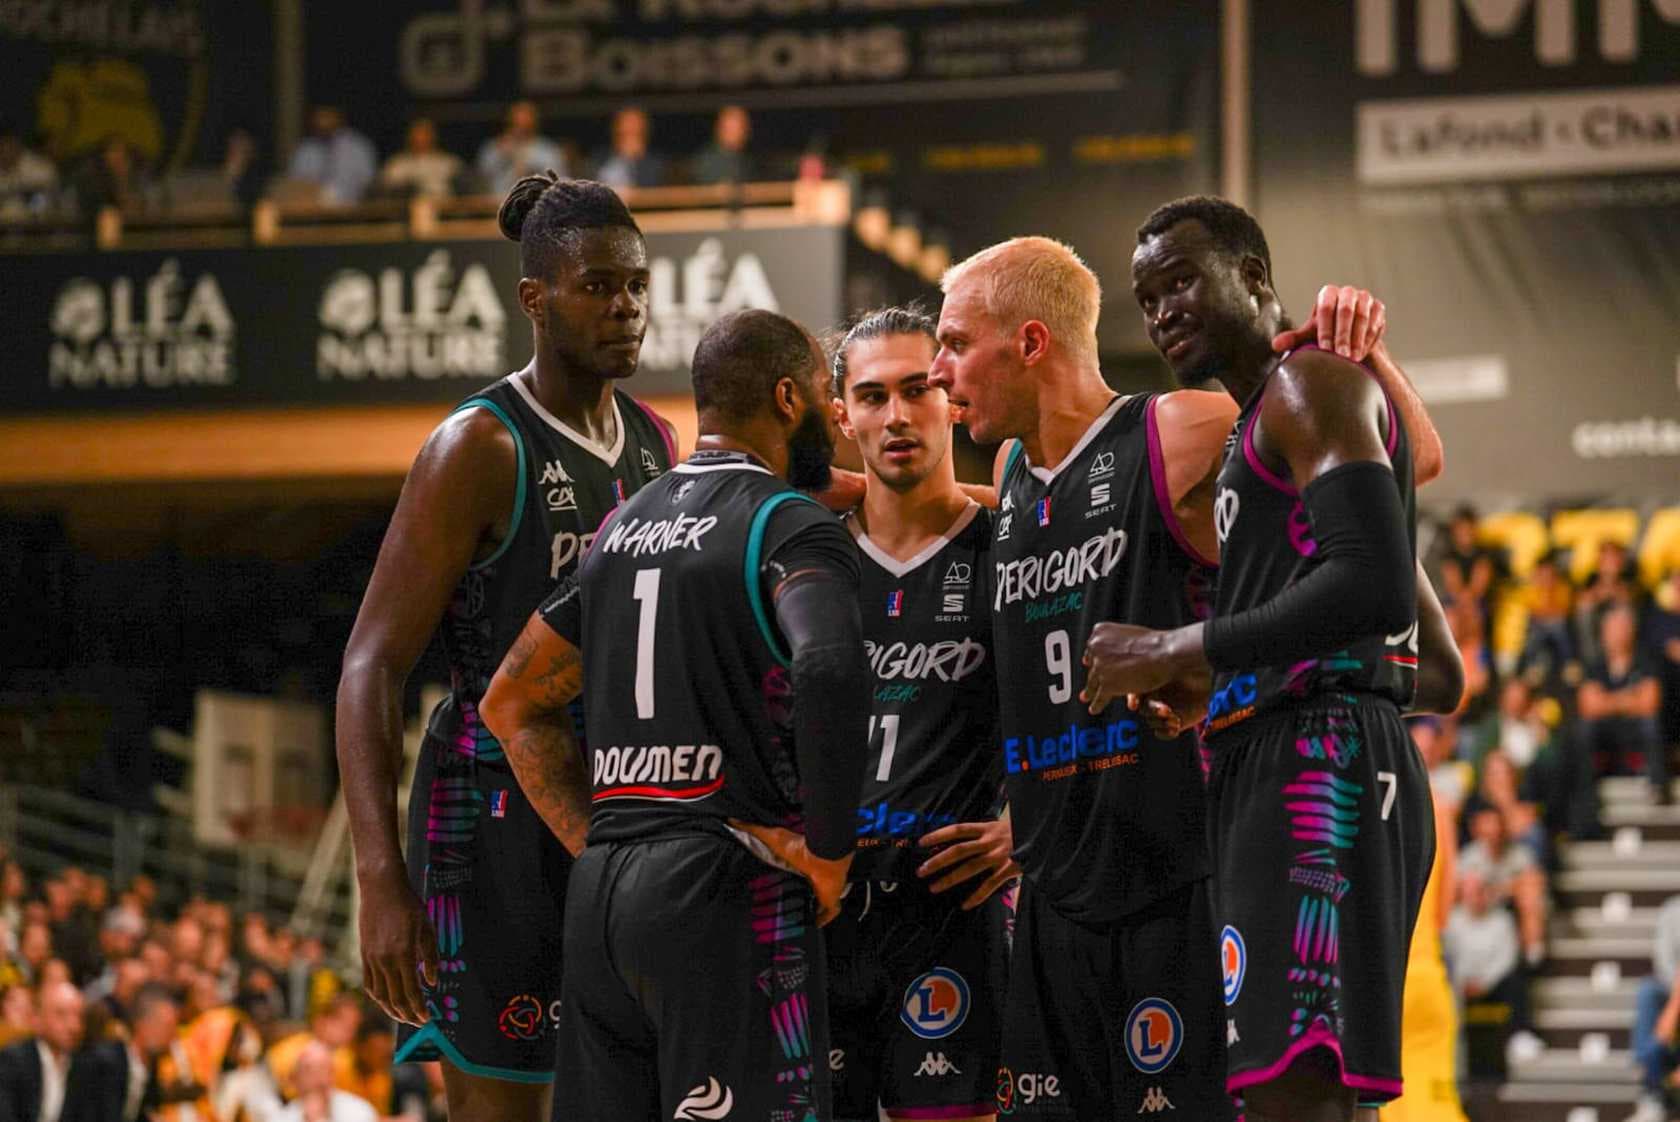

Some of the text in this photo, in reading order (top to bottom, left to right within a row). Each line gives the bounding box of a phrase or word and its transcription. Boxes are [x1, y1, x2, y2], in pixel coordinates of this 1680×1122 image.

[49, 336, 234, 387] NATURE
[316, 324, 503, 380] NATURE
[603, 512, 718, 558] WARNER
[1084, 504, 1118, 519] SEAT
[994, 526, 1129, 613] PERIGORD
[633, 567, 661, 720] 1
[1045, 629, 1072, 705] 9
[1003, 719, 1138, 774] E.Leclerc
[1376, 771, 1397, 821] 7
[1018, 1073, 1060, 1104] gie
